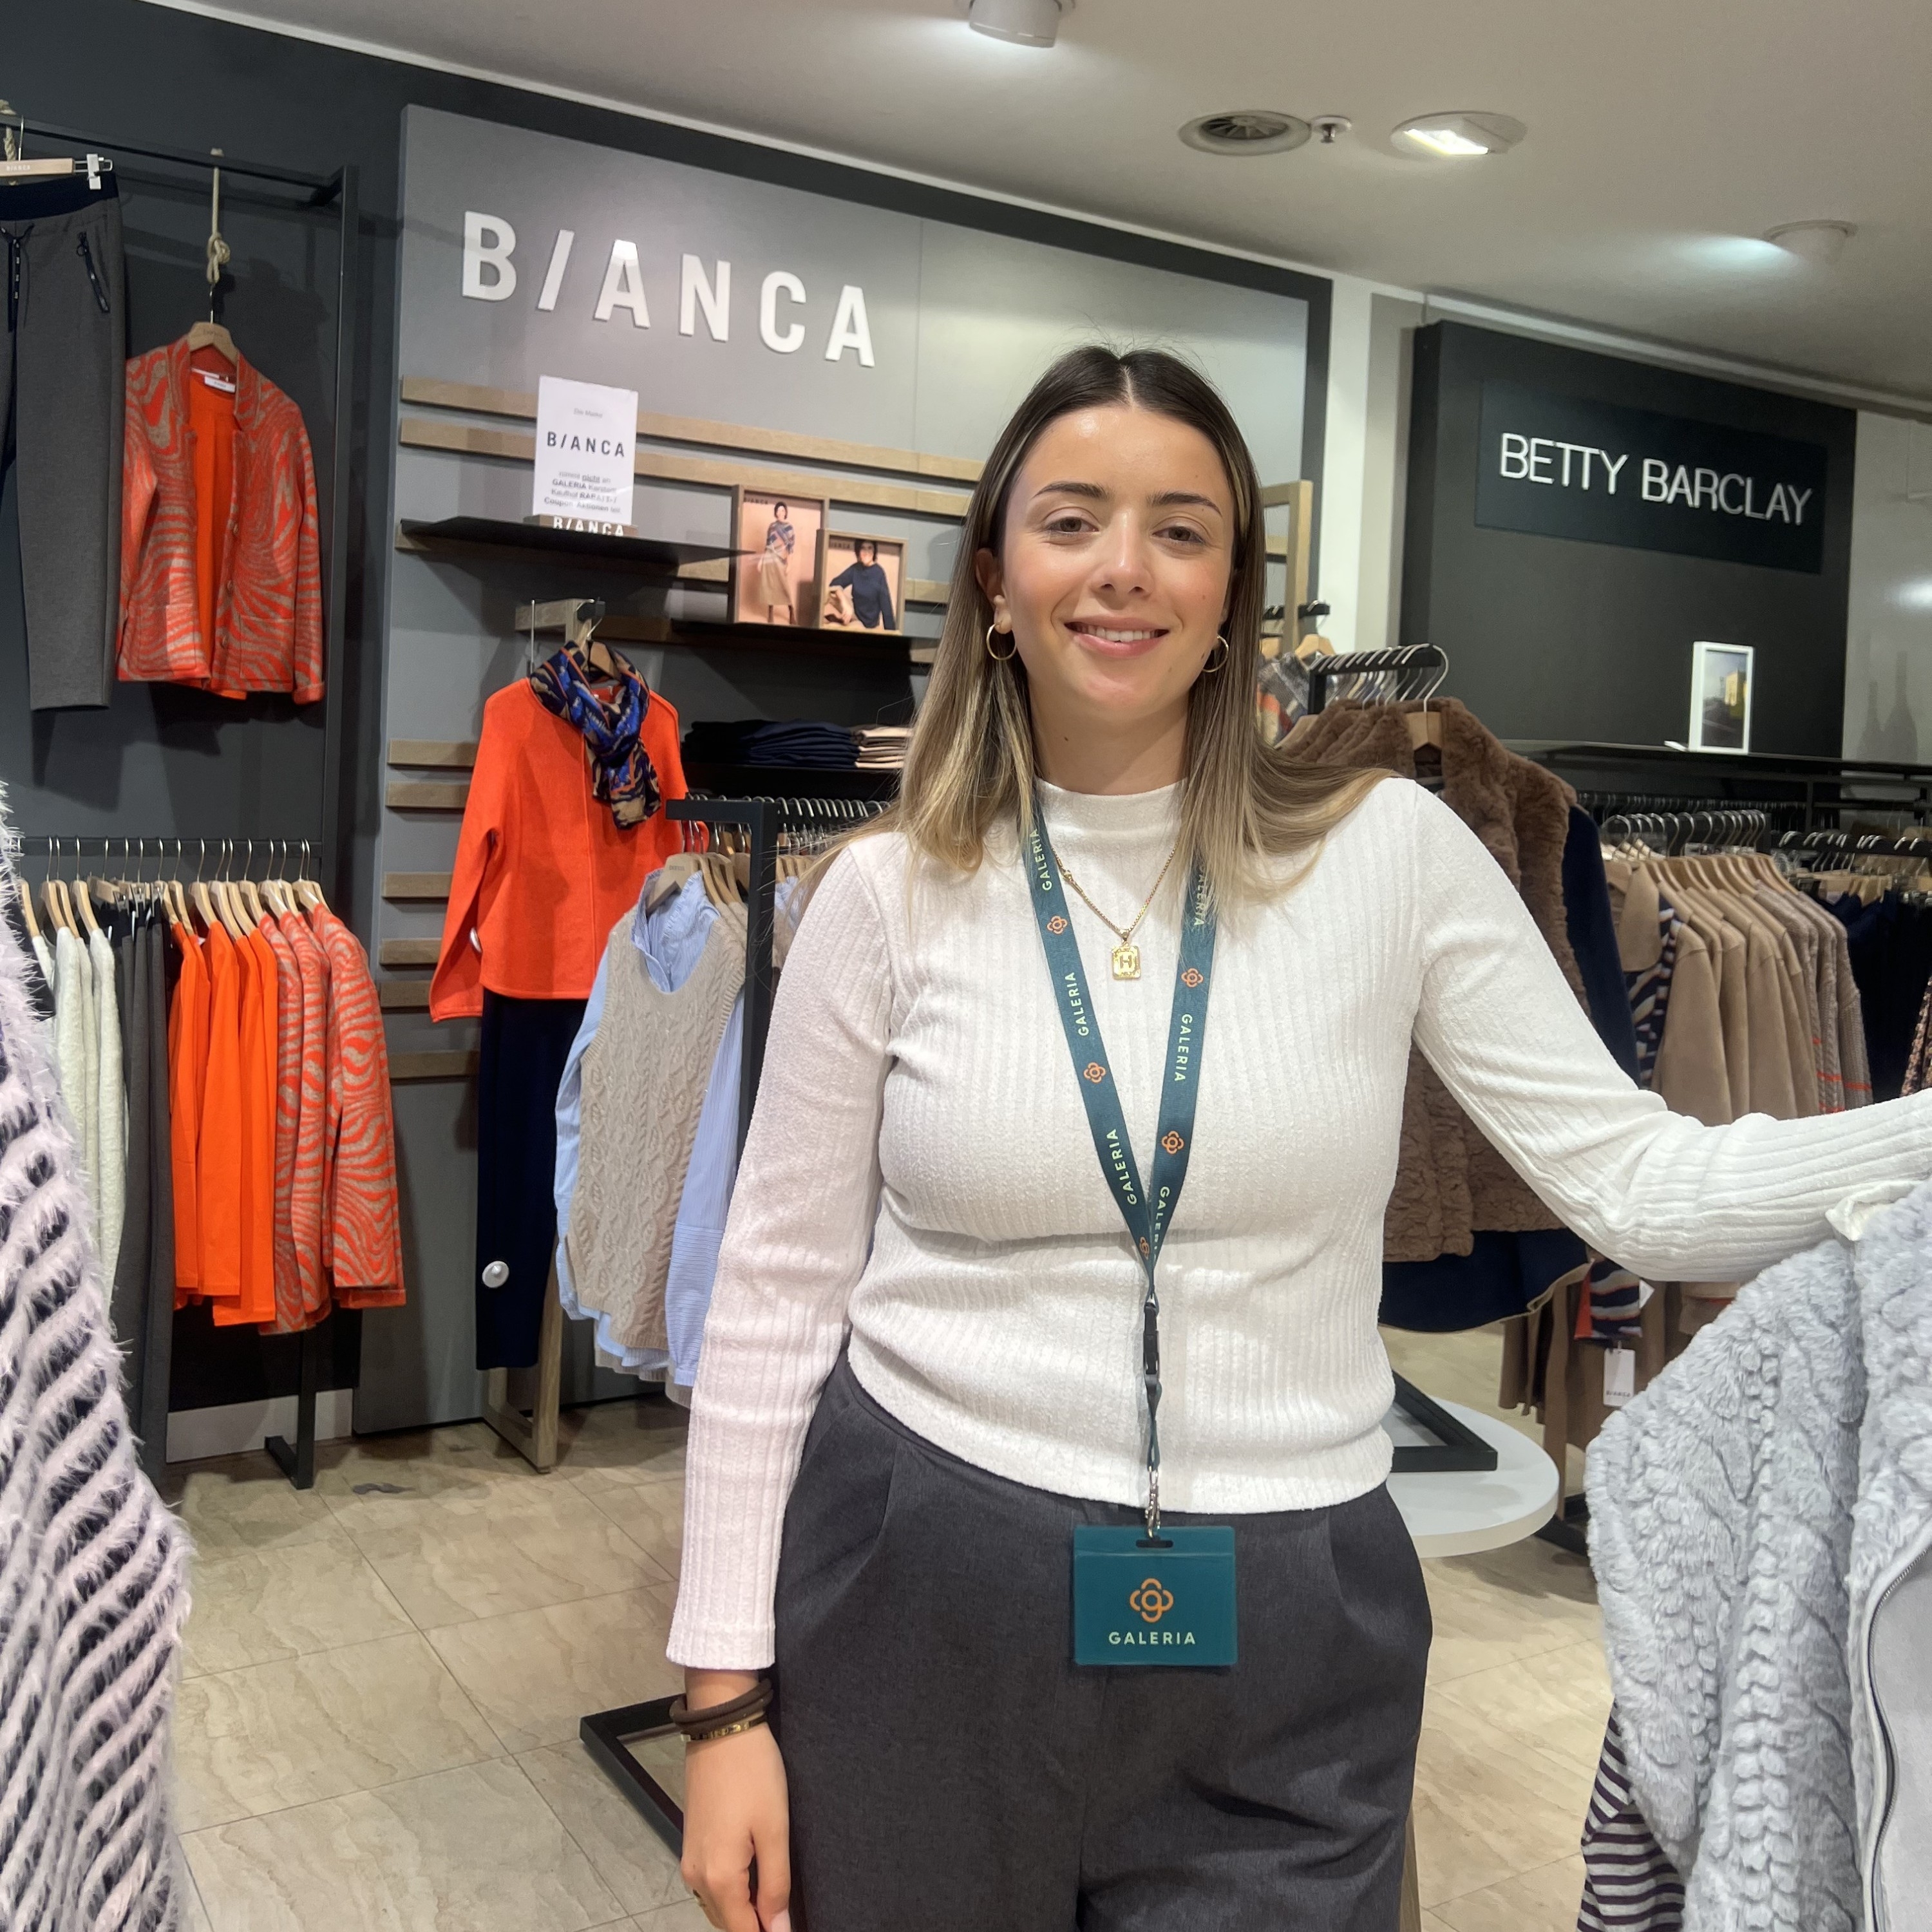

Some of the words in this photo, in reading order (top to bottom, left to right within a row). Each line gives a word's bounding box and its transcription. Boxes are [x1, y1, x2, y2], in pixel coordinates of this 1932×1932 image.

[552, 478, 587, 489] GALERIA
[1499, 432, 1629, 495] BETTY
[1642, 458, 1812, 526] BARCLAY
[1030, 828, 1053, 891] GALERIA
[1065, 971, 1090, 1037] GALERIA
[1173, 1013, 1194, 1083] GALERIA
[1106, 1128, 1138, 1205] GALERIA
[1108, 1631, 1197, 1645] GALERIA
